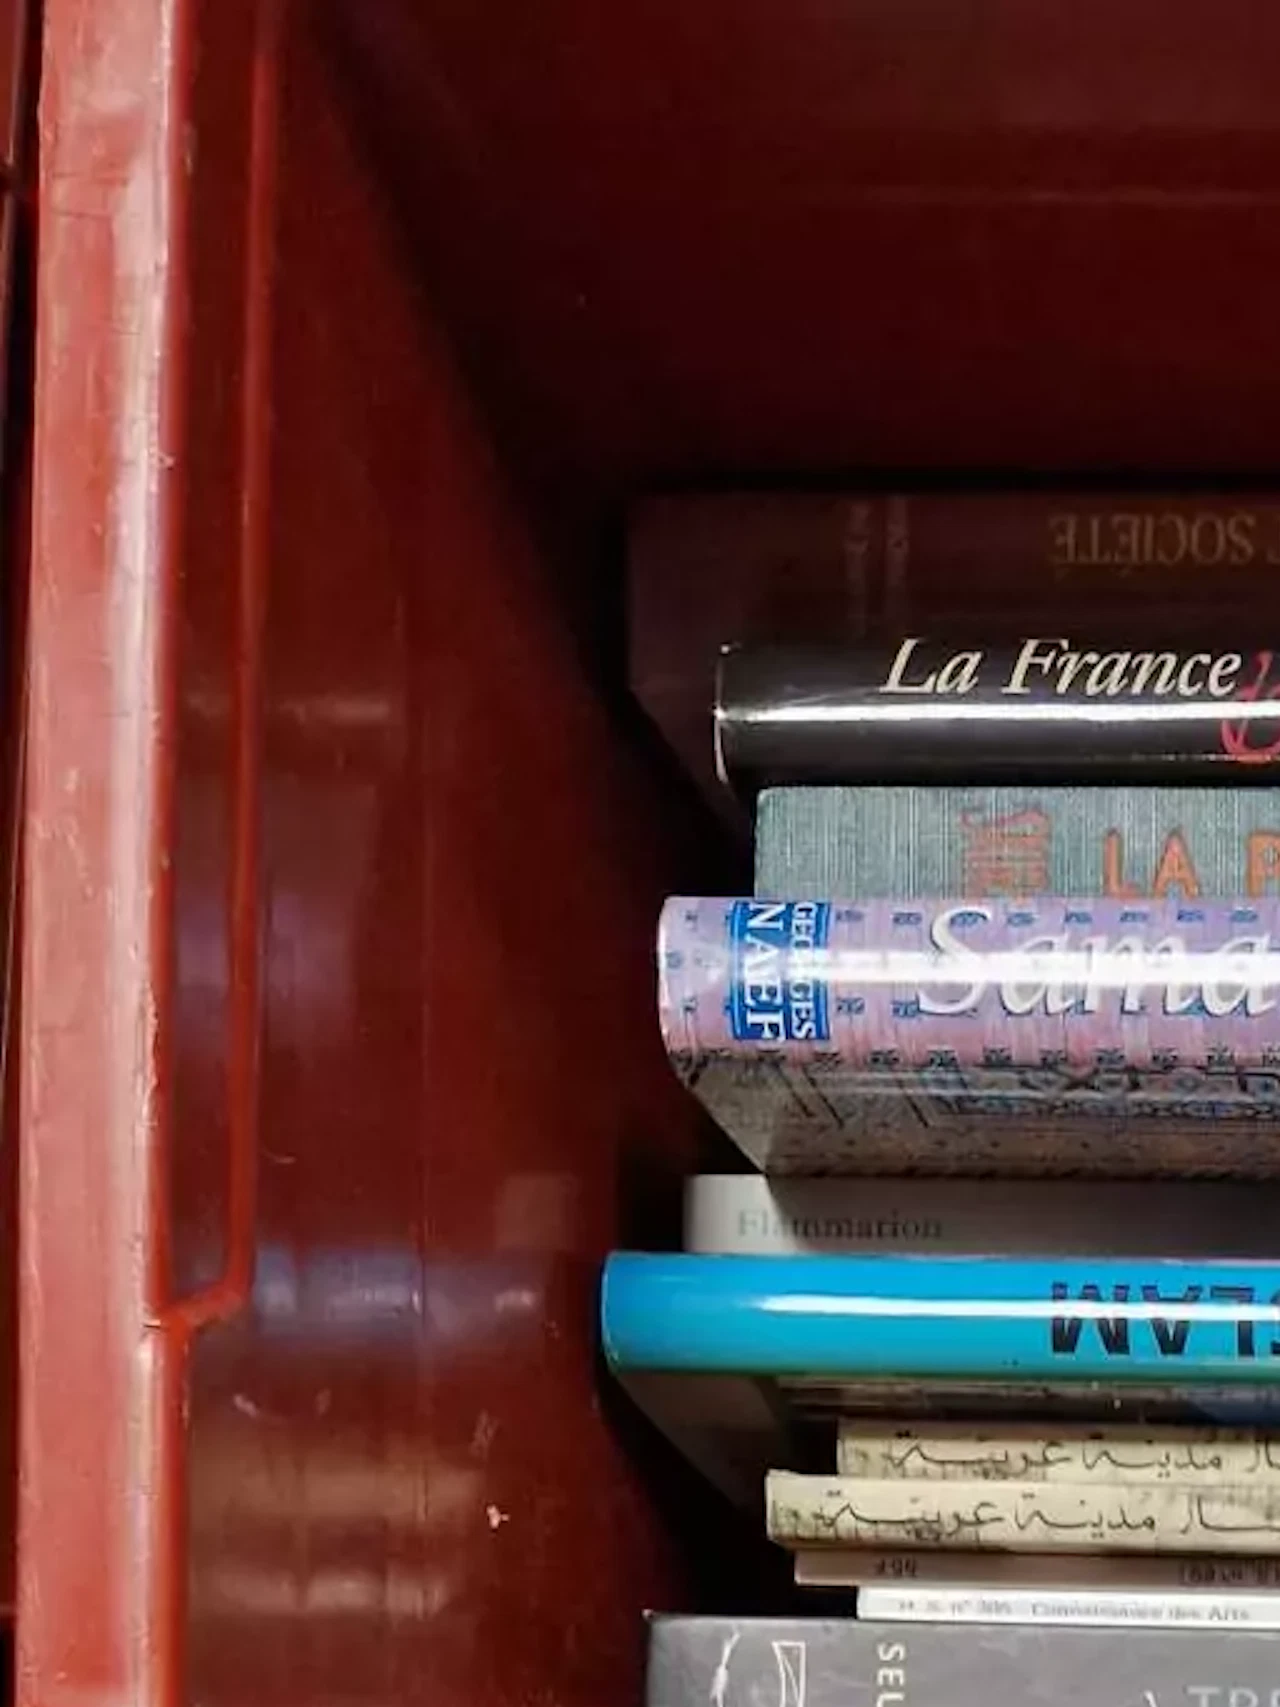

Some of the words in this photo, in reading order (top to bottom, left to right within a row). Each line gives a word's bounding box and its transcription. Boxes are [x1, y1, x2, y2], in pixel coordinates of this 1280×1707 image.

[880, 637, 984, 695] La
[999, 637, 1244, 697] France
[1101, 829, 1199, 899] LA
[744, 900, 789, 1041] NAEF
[739, 1206, 944, 1238] Flammarion
